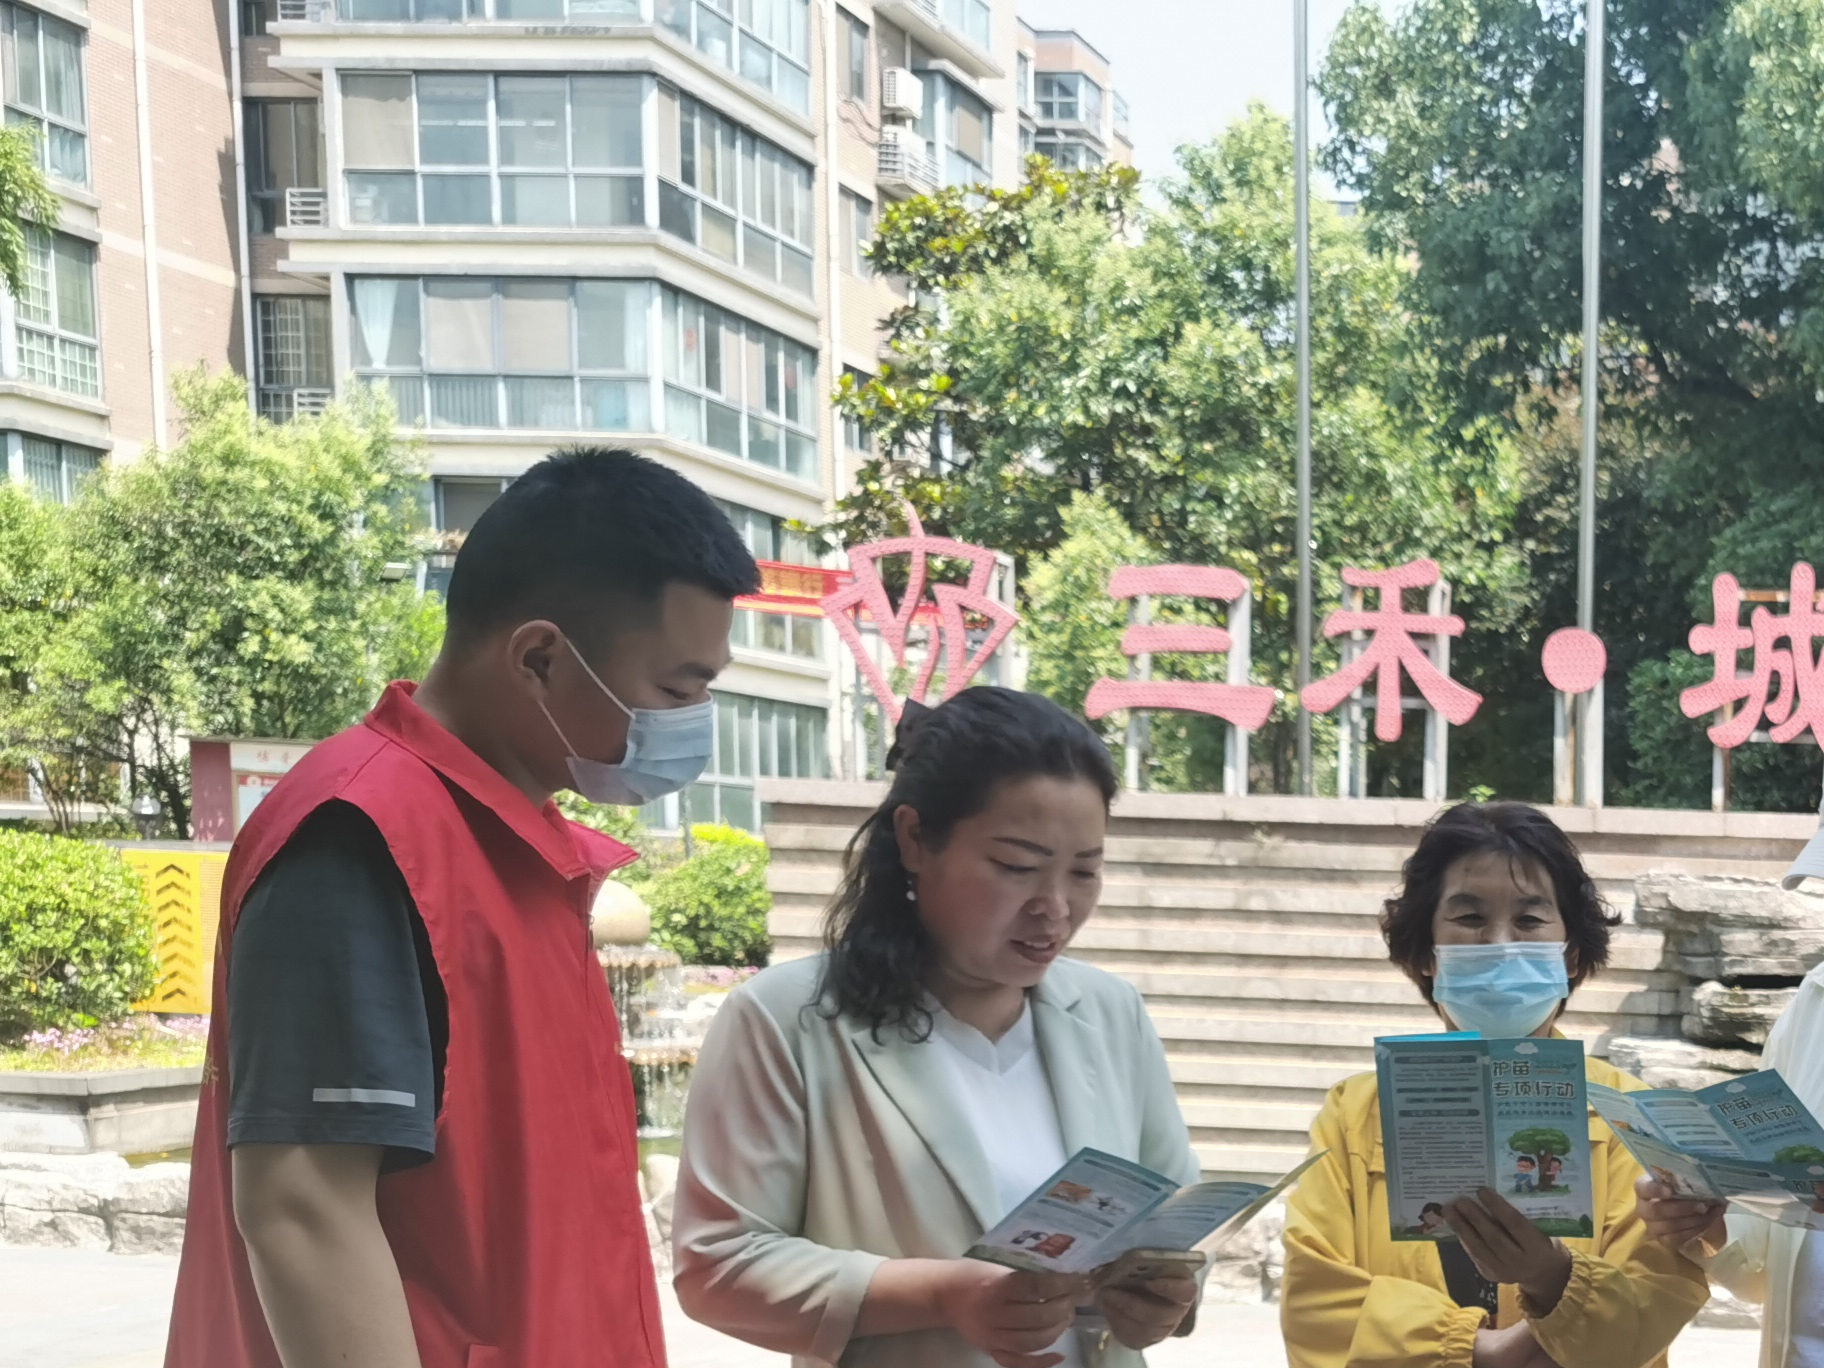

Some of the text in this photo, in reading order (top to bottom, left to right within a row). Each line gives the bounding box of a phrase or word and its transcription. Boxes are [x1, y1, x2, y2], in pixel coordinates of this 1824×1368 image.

[1492, 1060, 1530, 1077] 护苗
[1492, 1081, 1576, 1098] 专项行动
[1730, 1104, 1799, 1130] 专项行动
